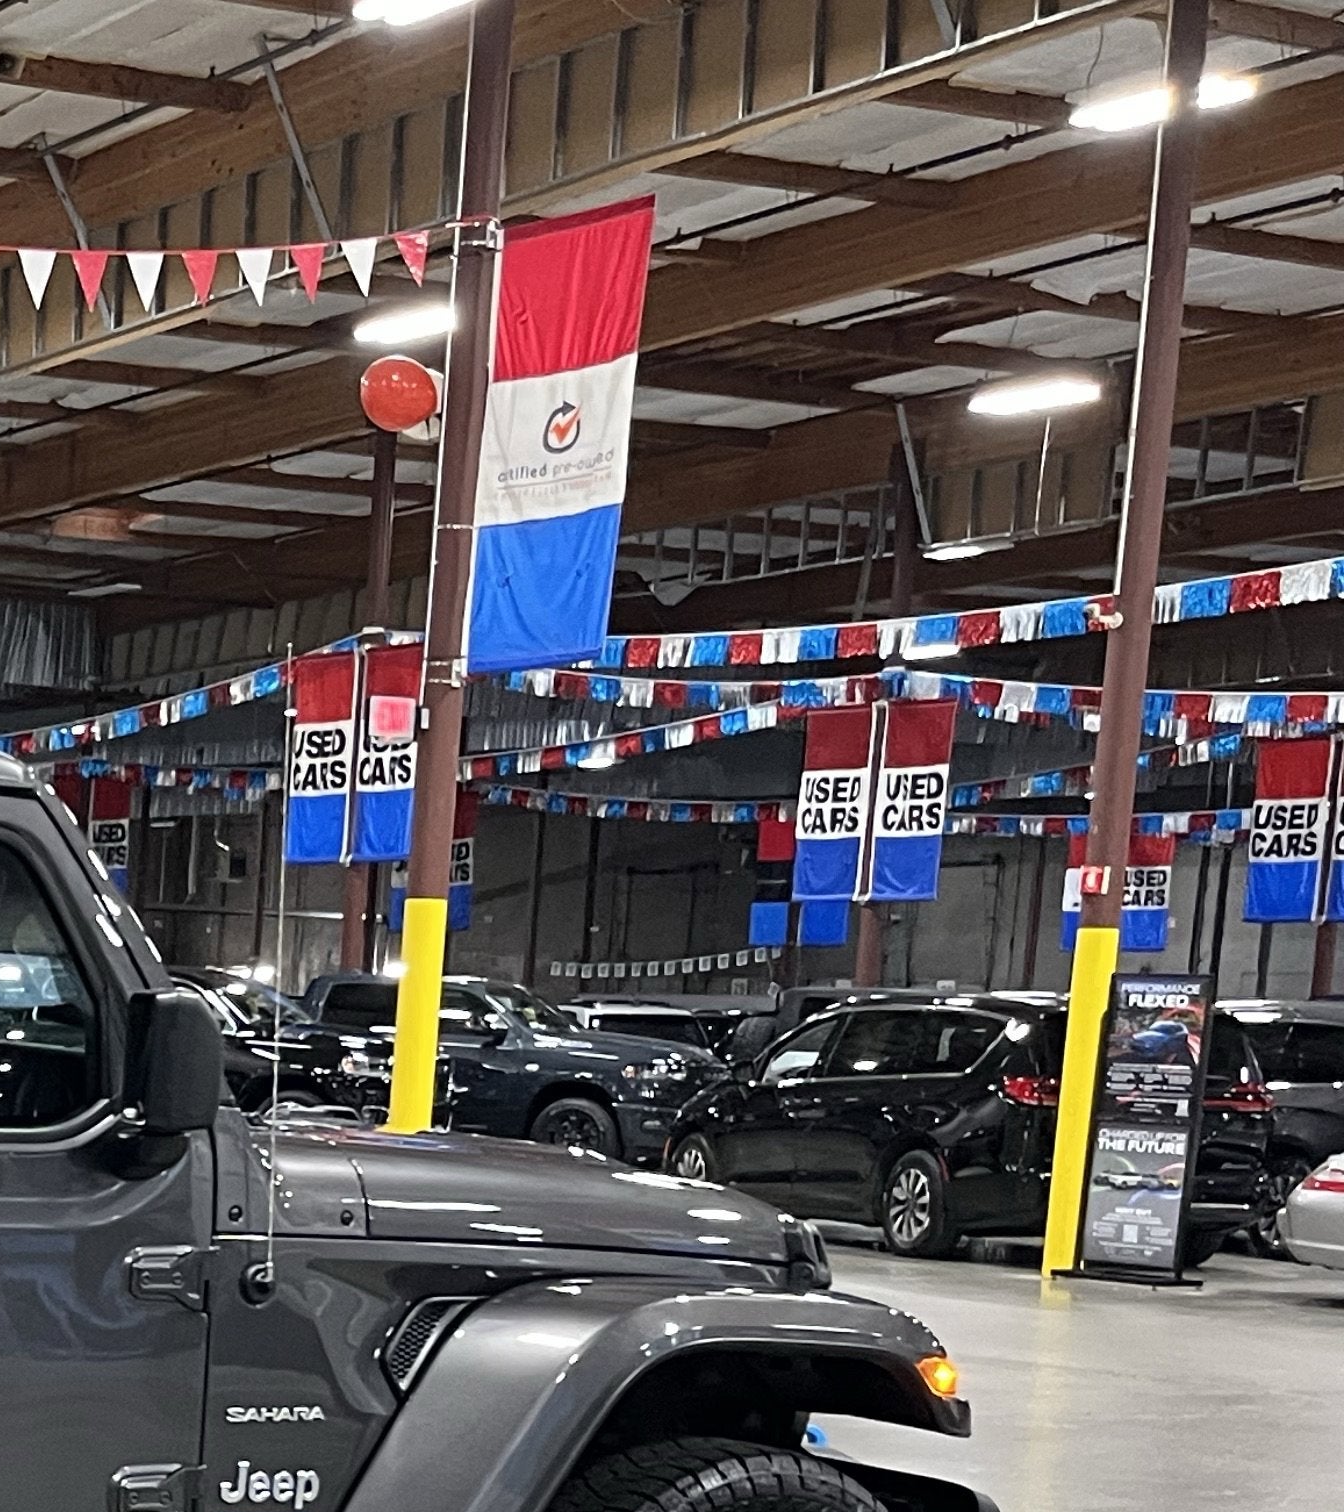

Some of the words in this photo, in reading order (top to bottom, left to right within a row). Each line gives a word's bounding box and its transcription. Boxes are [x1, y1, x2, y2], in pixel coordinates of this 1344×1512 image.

[294, 729, 347, 759] USED
[293, 760, 347, 791] CARS
[359, 754, 412, 786] CARS
[805, 776, 861, 803] USED
[886, 772, 944, 801] USED
[801, 806, 859, 834] CARS
[882, 802, 942, 832] CARS
[1254, 803, 1319, 831] USED
[1250, 831, 1317, 858] CARS
[1124, 869, 1167, 888] USED
[1122, 889, 1166, 907] CARS
[1128, 993, 1189, 1008] FLEXED
[1097, 1137, 1125, 1151] THE
[1127, 1139, 1185, 1155] FUTURE
[226, 1406, 326, 1422] SAHARA
[219, 1460, 320, 1510] Jeep
